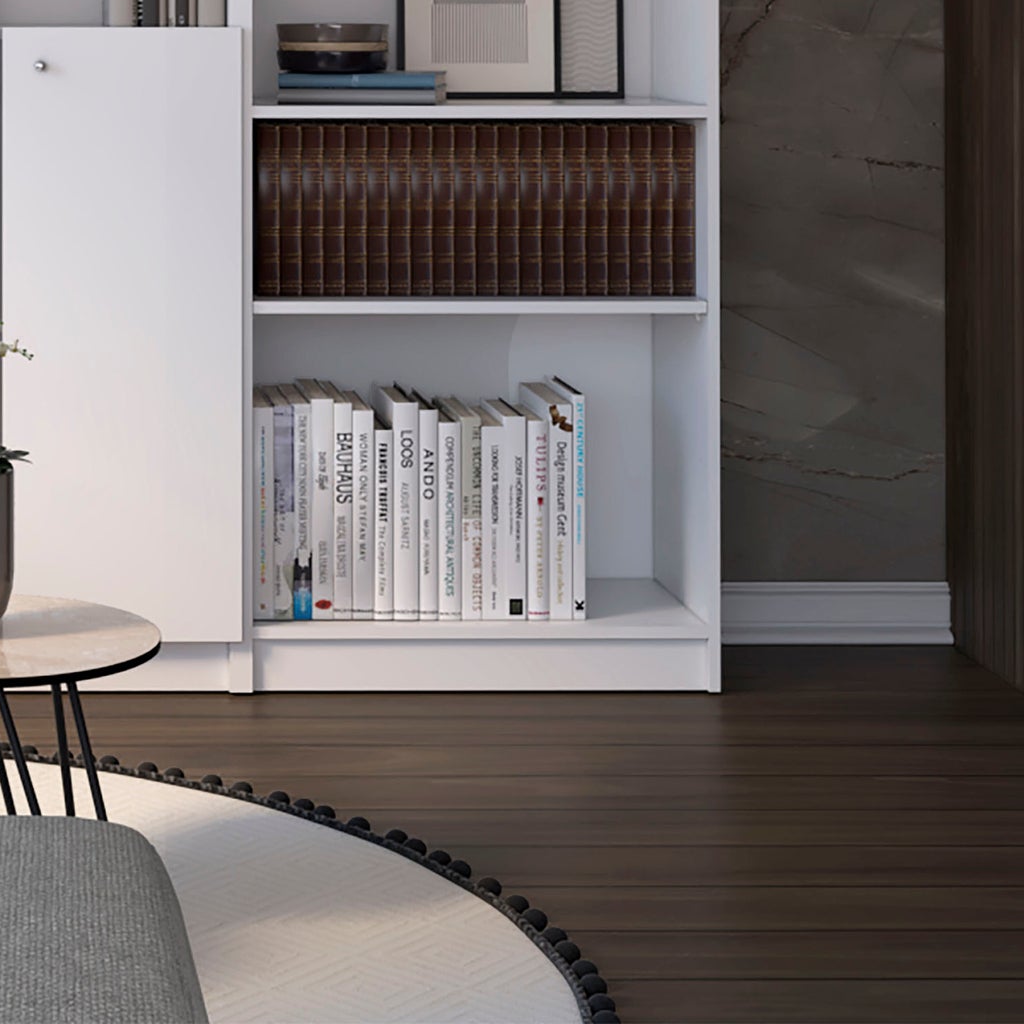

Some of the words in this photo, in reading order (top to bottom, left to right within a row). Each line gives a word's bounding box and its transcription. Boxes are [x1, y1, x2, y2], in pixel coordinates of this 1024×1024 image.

[360, 433, 368, 472] WOMAN
[401, 430, 413, 468] LOOS
[446, 436, 455, 489] COMPENDIUM
[536, 433, 547, 492] TULIPS
[554, 441, 567, 473] Design
[336, 432, 353, 504] BAUHAUS
[423, 448, 434, 500] ANDO
[360, 475, 368, 502] ONLY
[401, 482, 410, 513] AUGUST
[472, 494, 481, 515] LIFE
[557, 474, 566, 513] museum
[360, 505, 368, 540] STEFAN
[401, 516, 410, 550] SARNITZ
[446, 491, 455, 554] ARCHITECTURAL
[472, 520, 481, 531] OF
[557, 514, 567, 537] Gent
[360, 543, 368, 562] MAY
[472, 537, 481, 569] COMMON
[445, 556, 455, 597] ANTIQUES
[472, 574, 481, 612] OBJECTS
